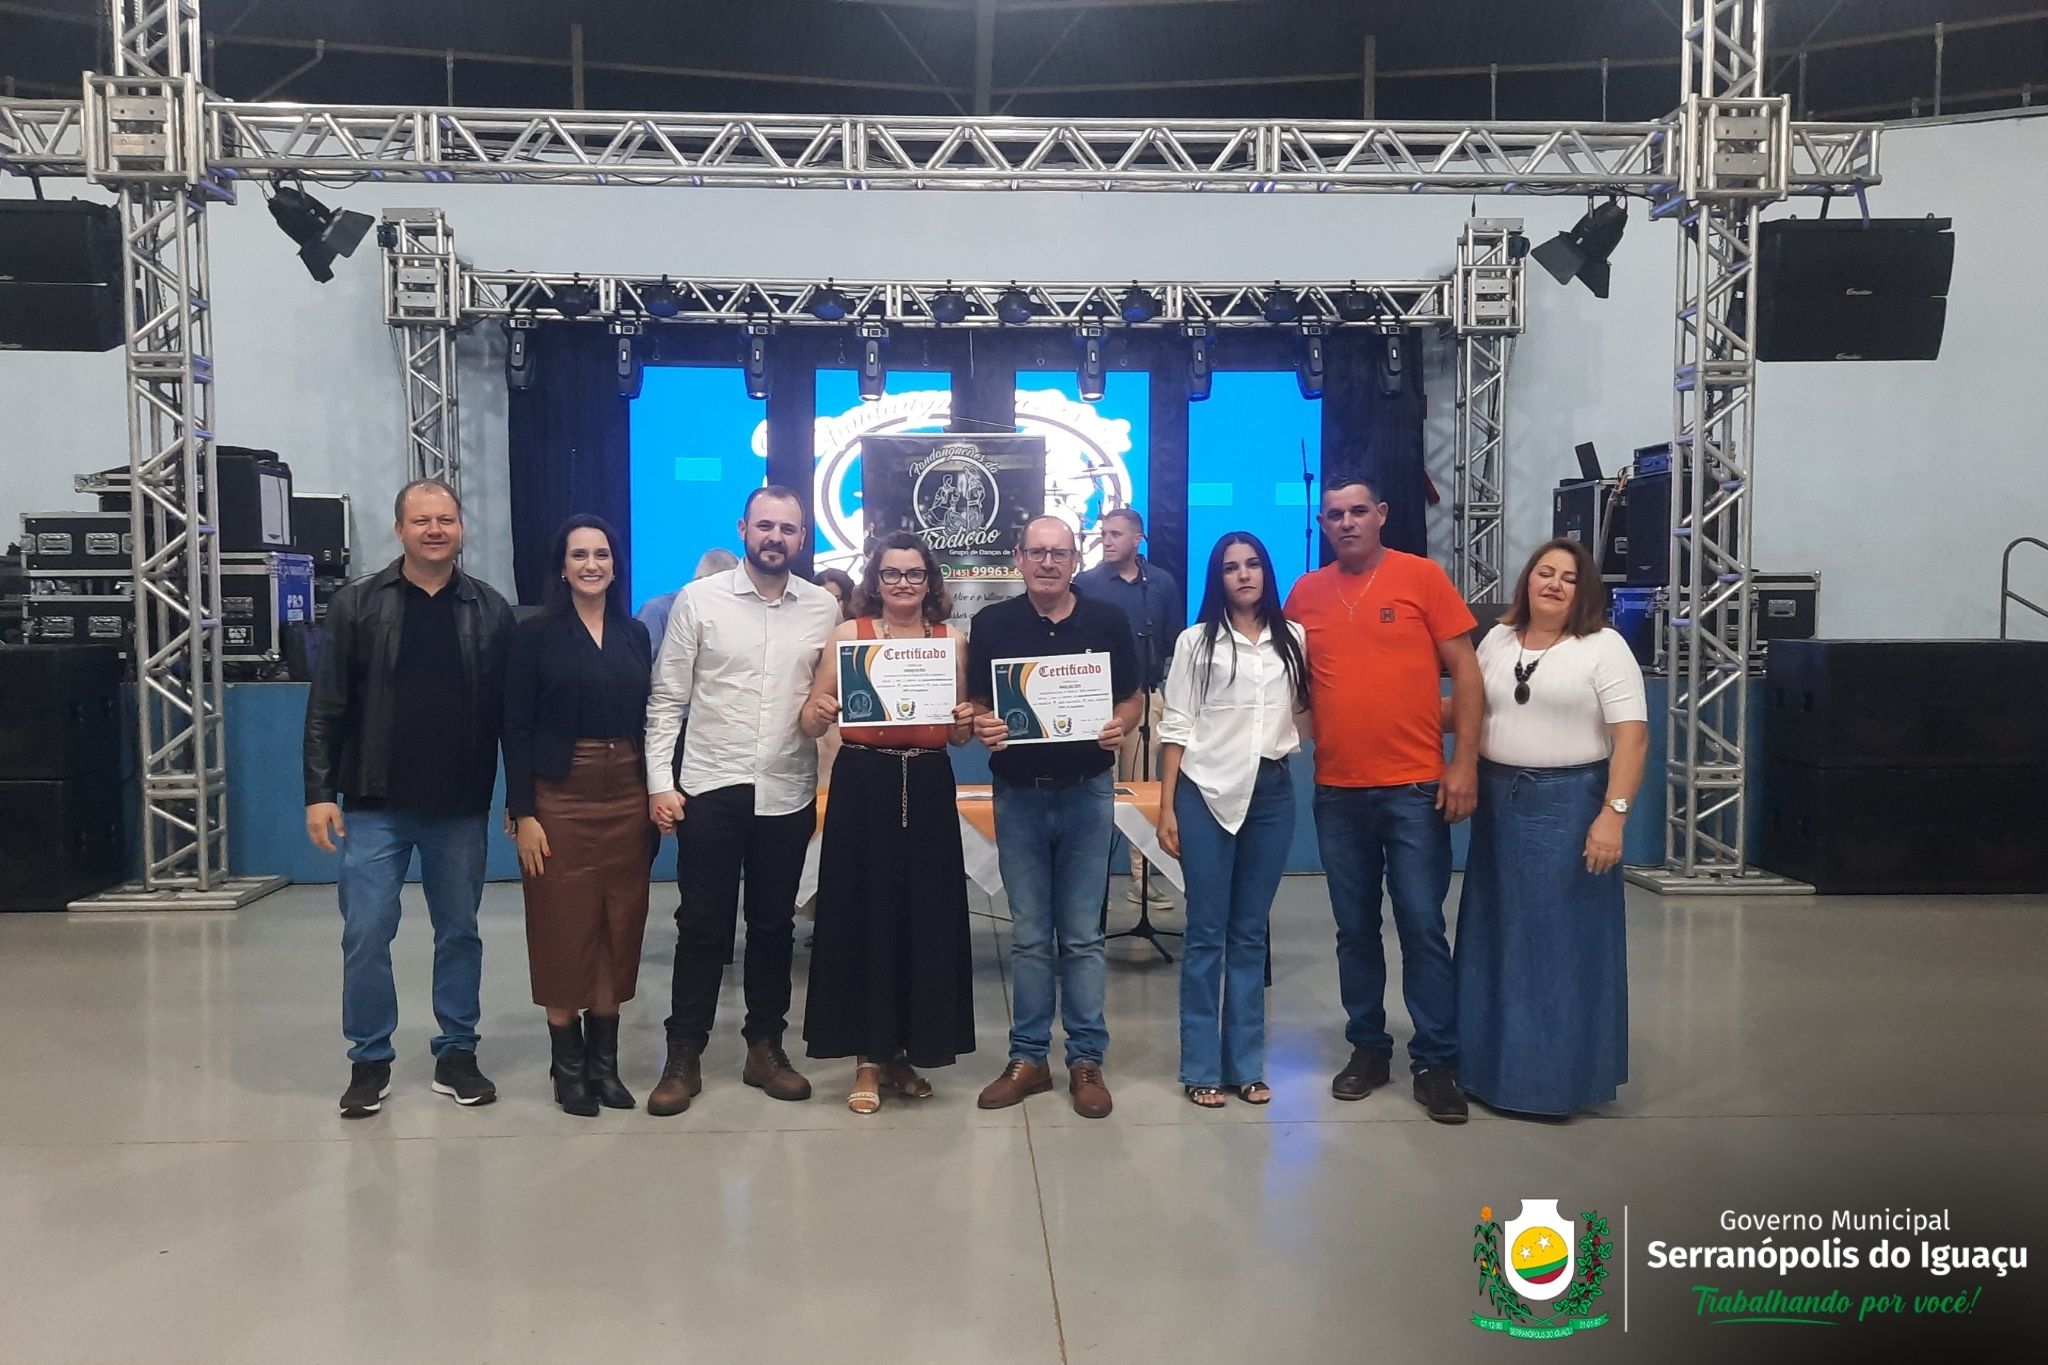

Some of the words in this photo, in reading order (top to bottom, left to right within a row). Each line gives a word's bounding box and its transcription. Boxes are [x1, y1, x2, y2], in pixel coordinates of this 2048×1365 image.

[915, 525, 1001, 550] Tradição
[952, 568, 970, 578] (45)
[971, 566, 1023, 577] 99963-6
[883, 648, 946, 660] Certificado
[1038, 663, 1102, 677] Certificado
